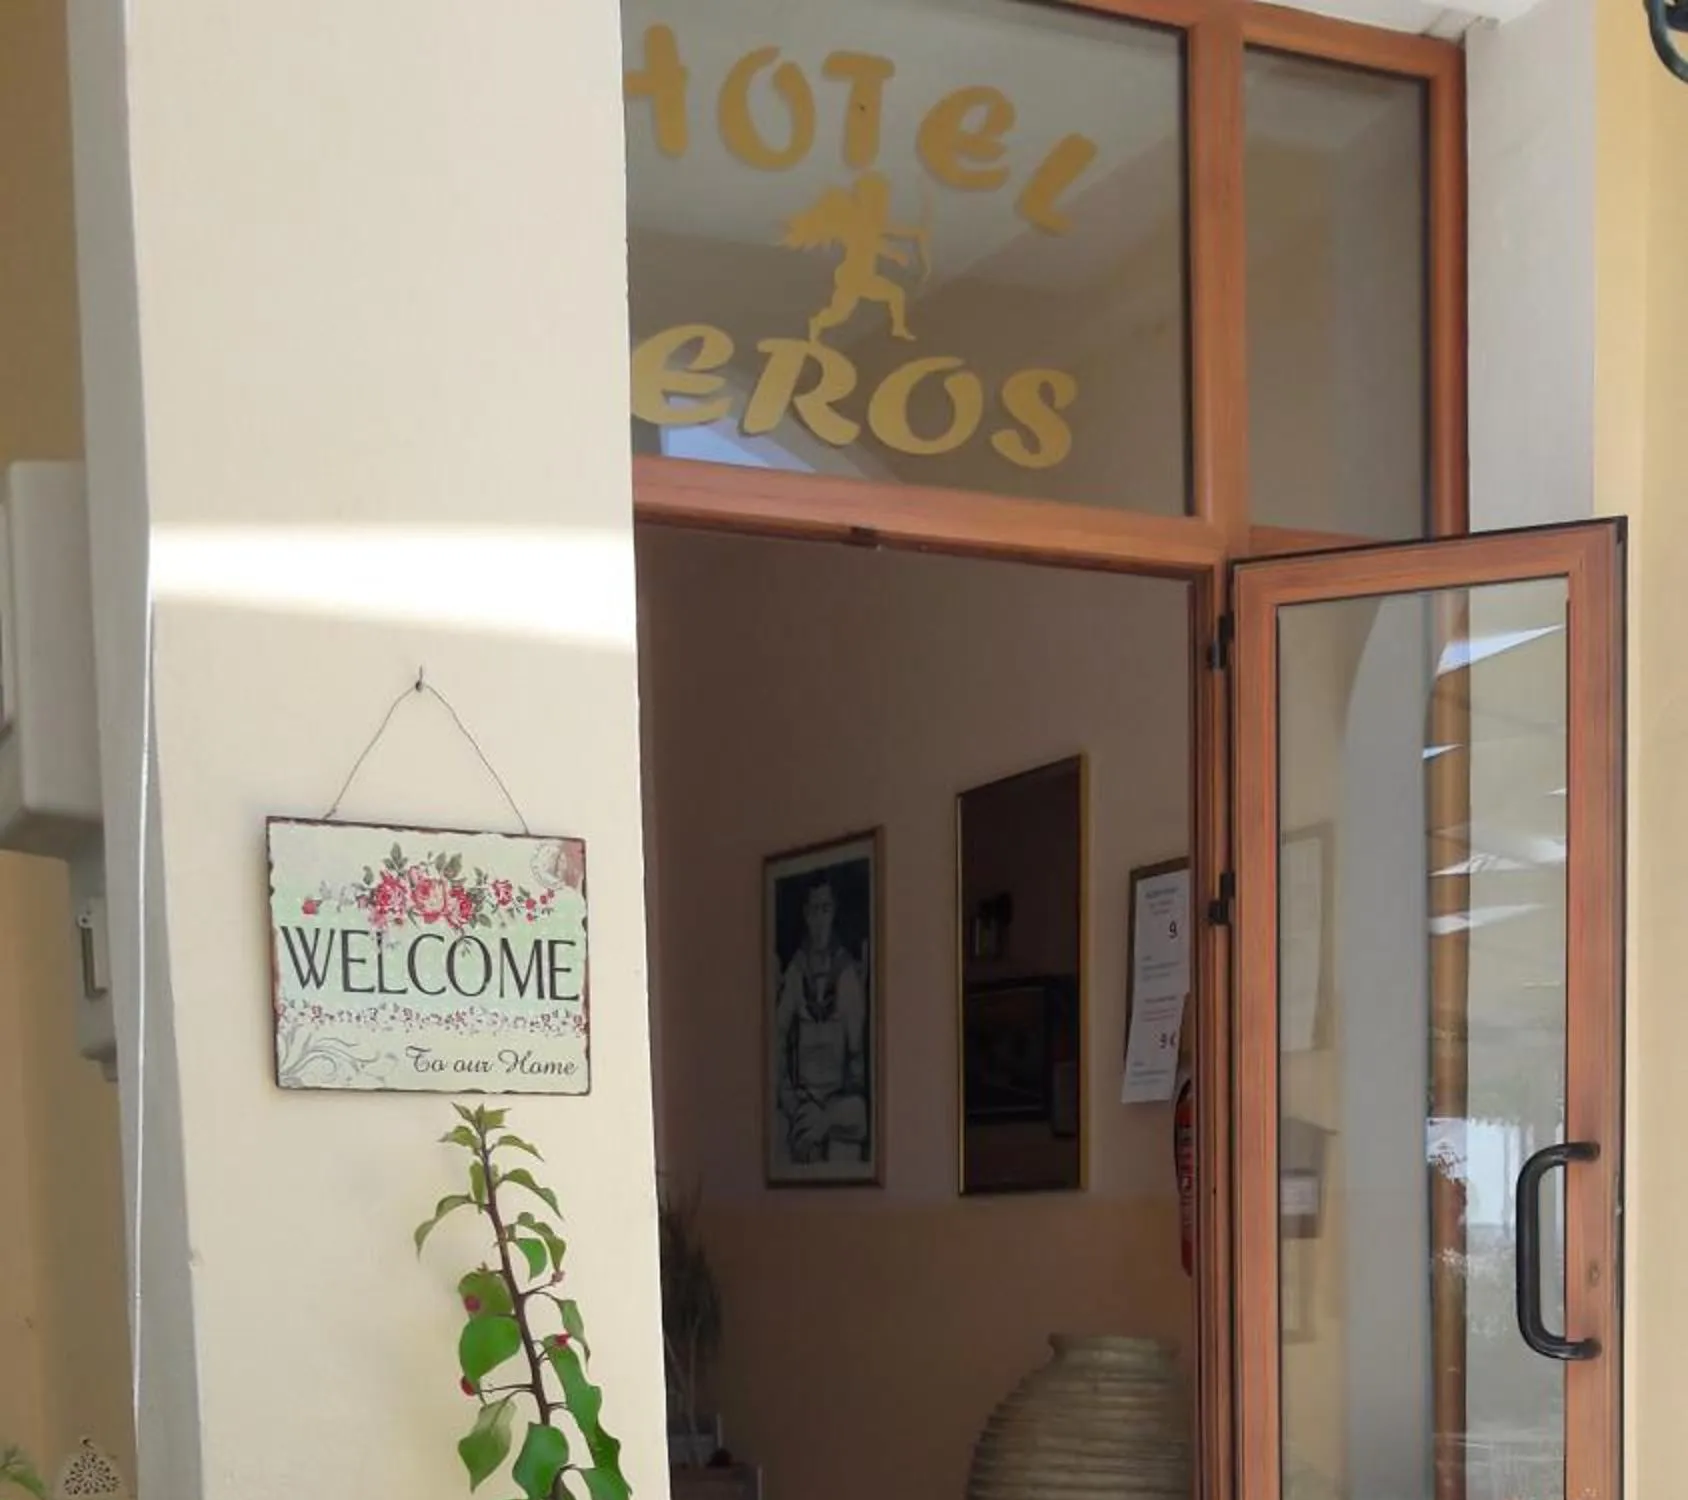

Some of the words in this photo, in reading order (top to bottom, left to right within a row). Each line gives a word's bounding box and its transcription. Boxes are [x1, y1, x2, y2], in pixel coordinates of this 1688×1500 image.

[280, 926, 580, 1001] WELCOME
[405, 1045, 445, 1073] To
[453, 1059, 494, 1073] our
[497, 1050, 578, 1075] Home
